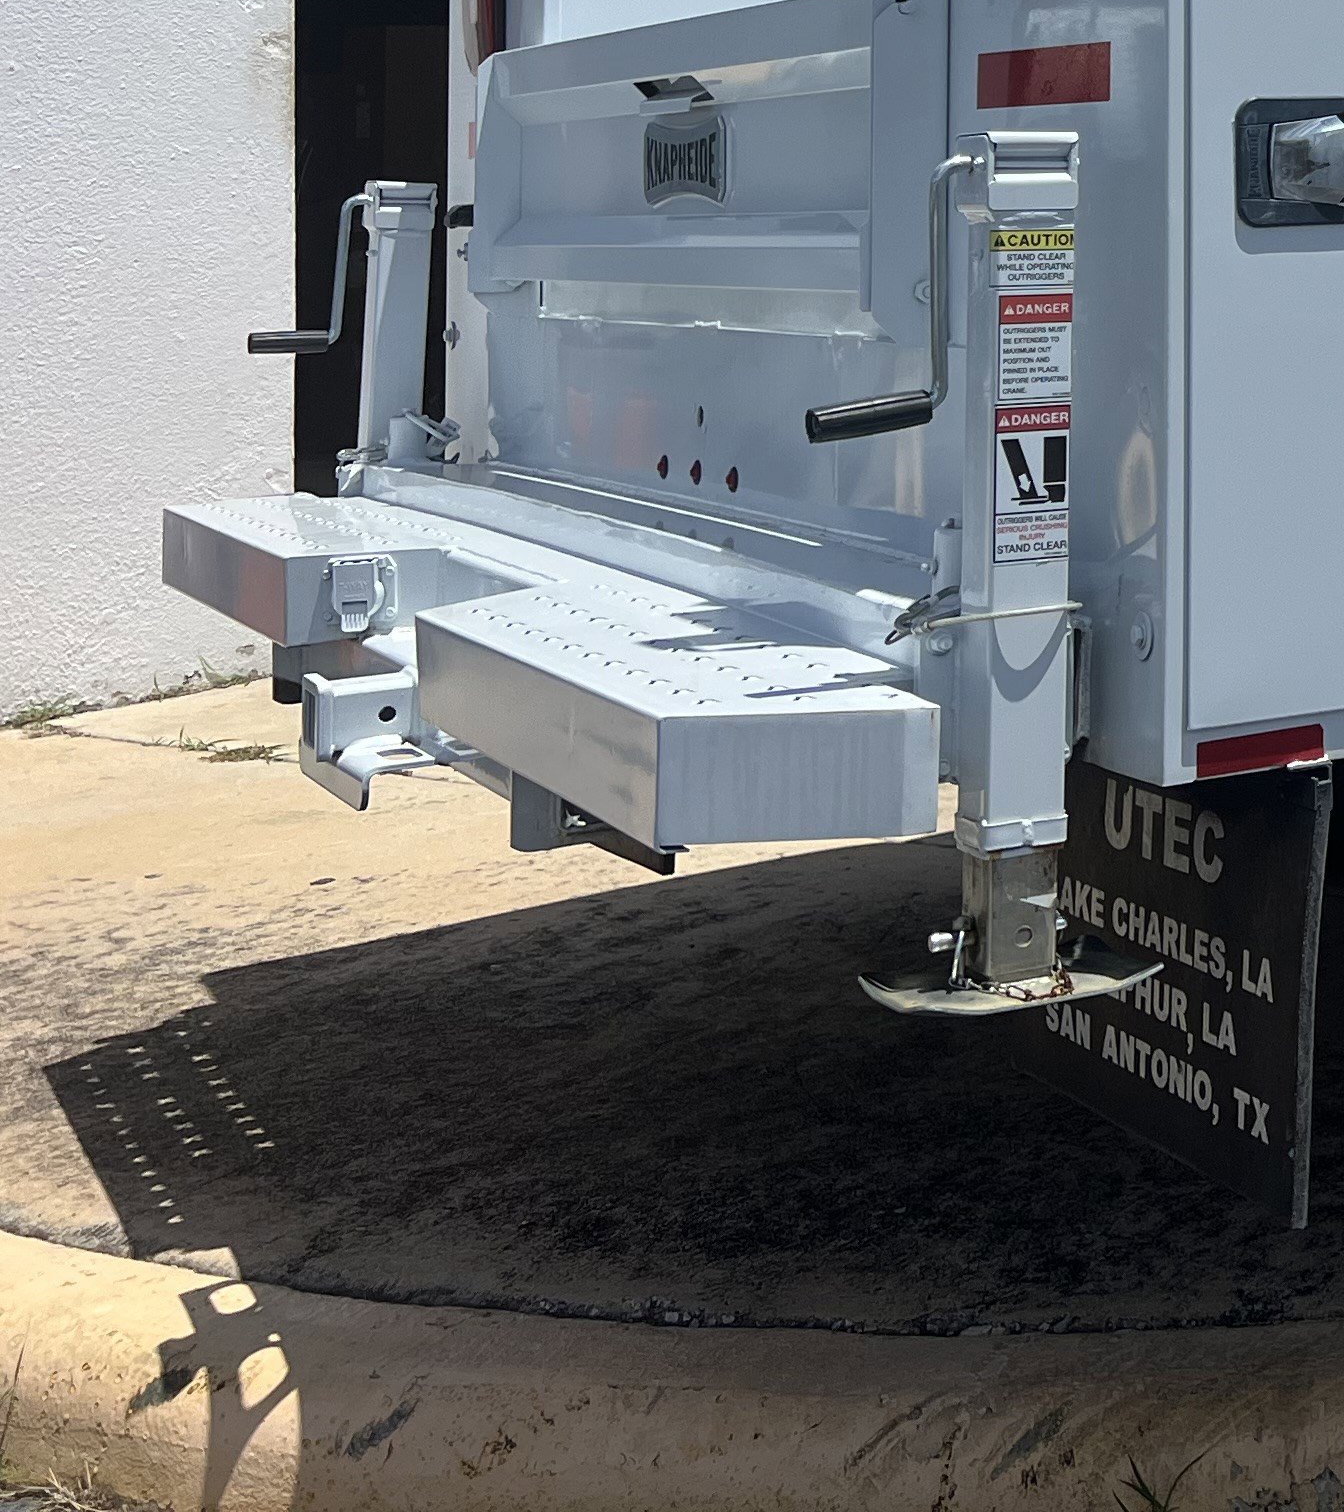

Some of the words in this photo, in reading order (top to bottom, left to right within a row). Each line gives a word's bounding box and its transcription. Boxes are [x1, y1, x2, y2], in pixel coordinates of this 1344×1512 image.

[646, 132, 717, 190] KNAPHEIDE
[1007, 253, 1035, 261] STAND
[1037, 252, 1066, 261] CLEAR
[997, 263, 1024, 271] WHILE
[1007, 272, 1065, 281] OUTRIGGERS
[1016, 303, 1069, 315] DANGER
[1048, 325, 1067, 333] MUST
[1014, 336, 1049, 344] EXTENDED
[1002, 377, 1029, 385] BEFORE
[1030, 375, 1069, 383] OPERATING
[1011, 412, 1069, 426] DANGER
[997, 516, 1033, 525] OUTRIGGERS
[1048, 512, 1067, 520] CAUSE
[997, 524, 1028, 534] SERIOUS
[1030, 521, 1067, 531] CRUSHING
[997, 543, 1031, 554] STAND
[1033, 540, 1067, 551] CLEAR
[1103, 777, 1226, 884] UTEC
[1058, 875, 1105, 928] AKE
[1112, 896, 1233, 994] CHARLES,
[1241, 949, 1274, 1004] LA
[1202, 1001, 1238, 1056] LA
[1045, 1001, 1091, 1051] SAN
[1101, 1024, 1222, 1126] ANTONIO,
[1233, 1086, 1270, 1145] TX
